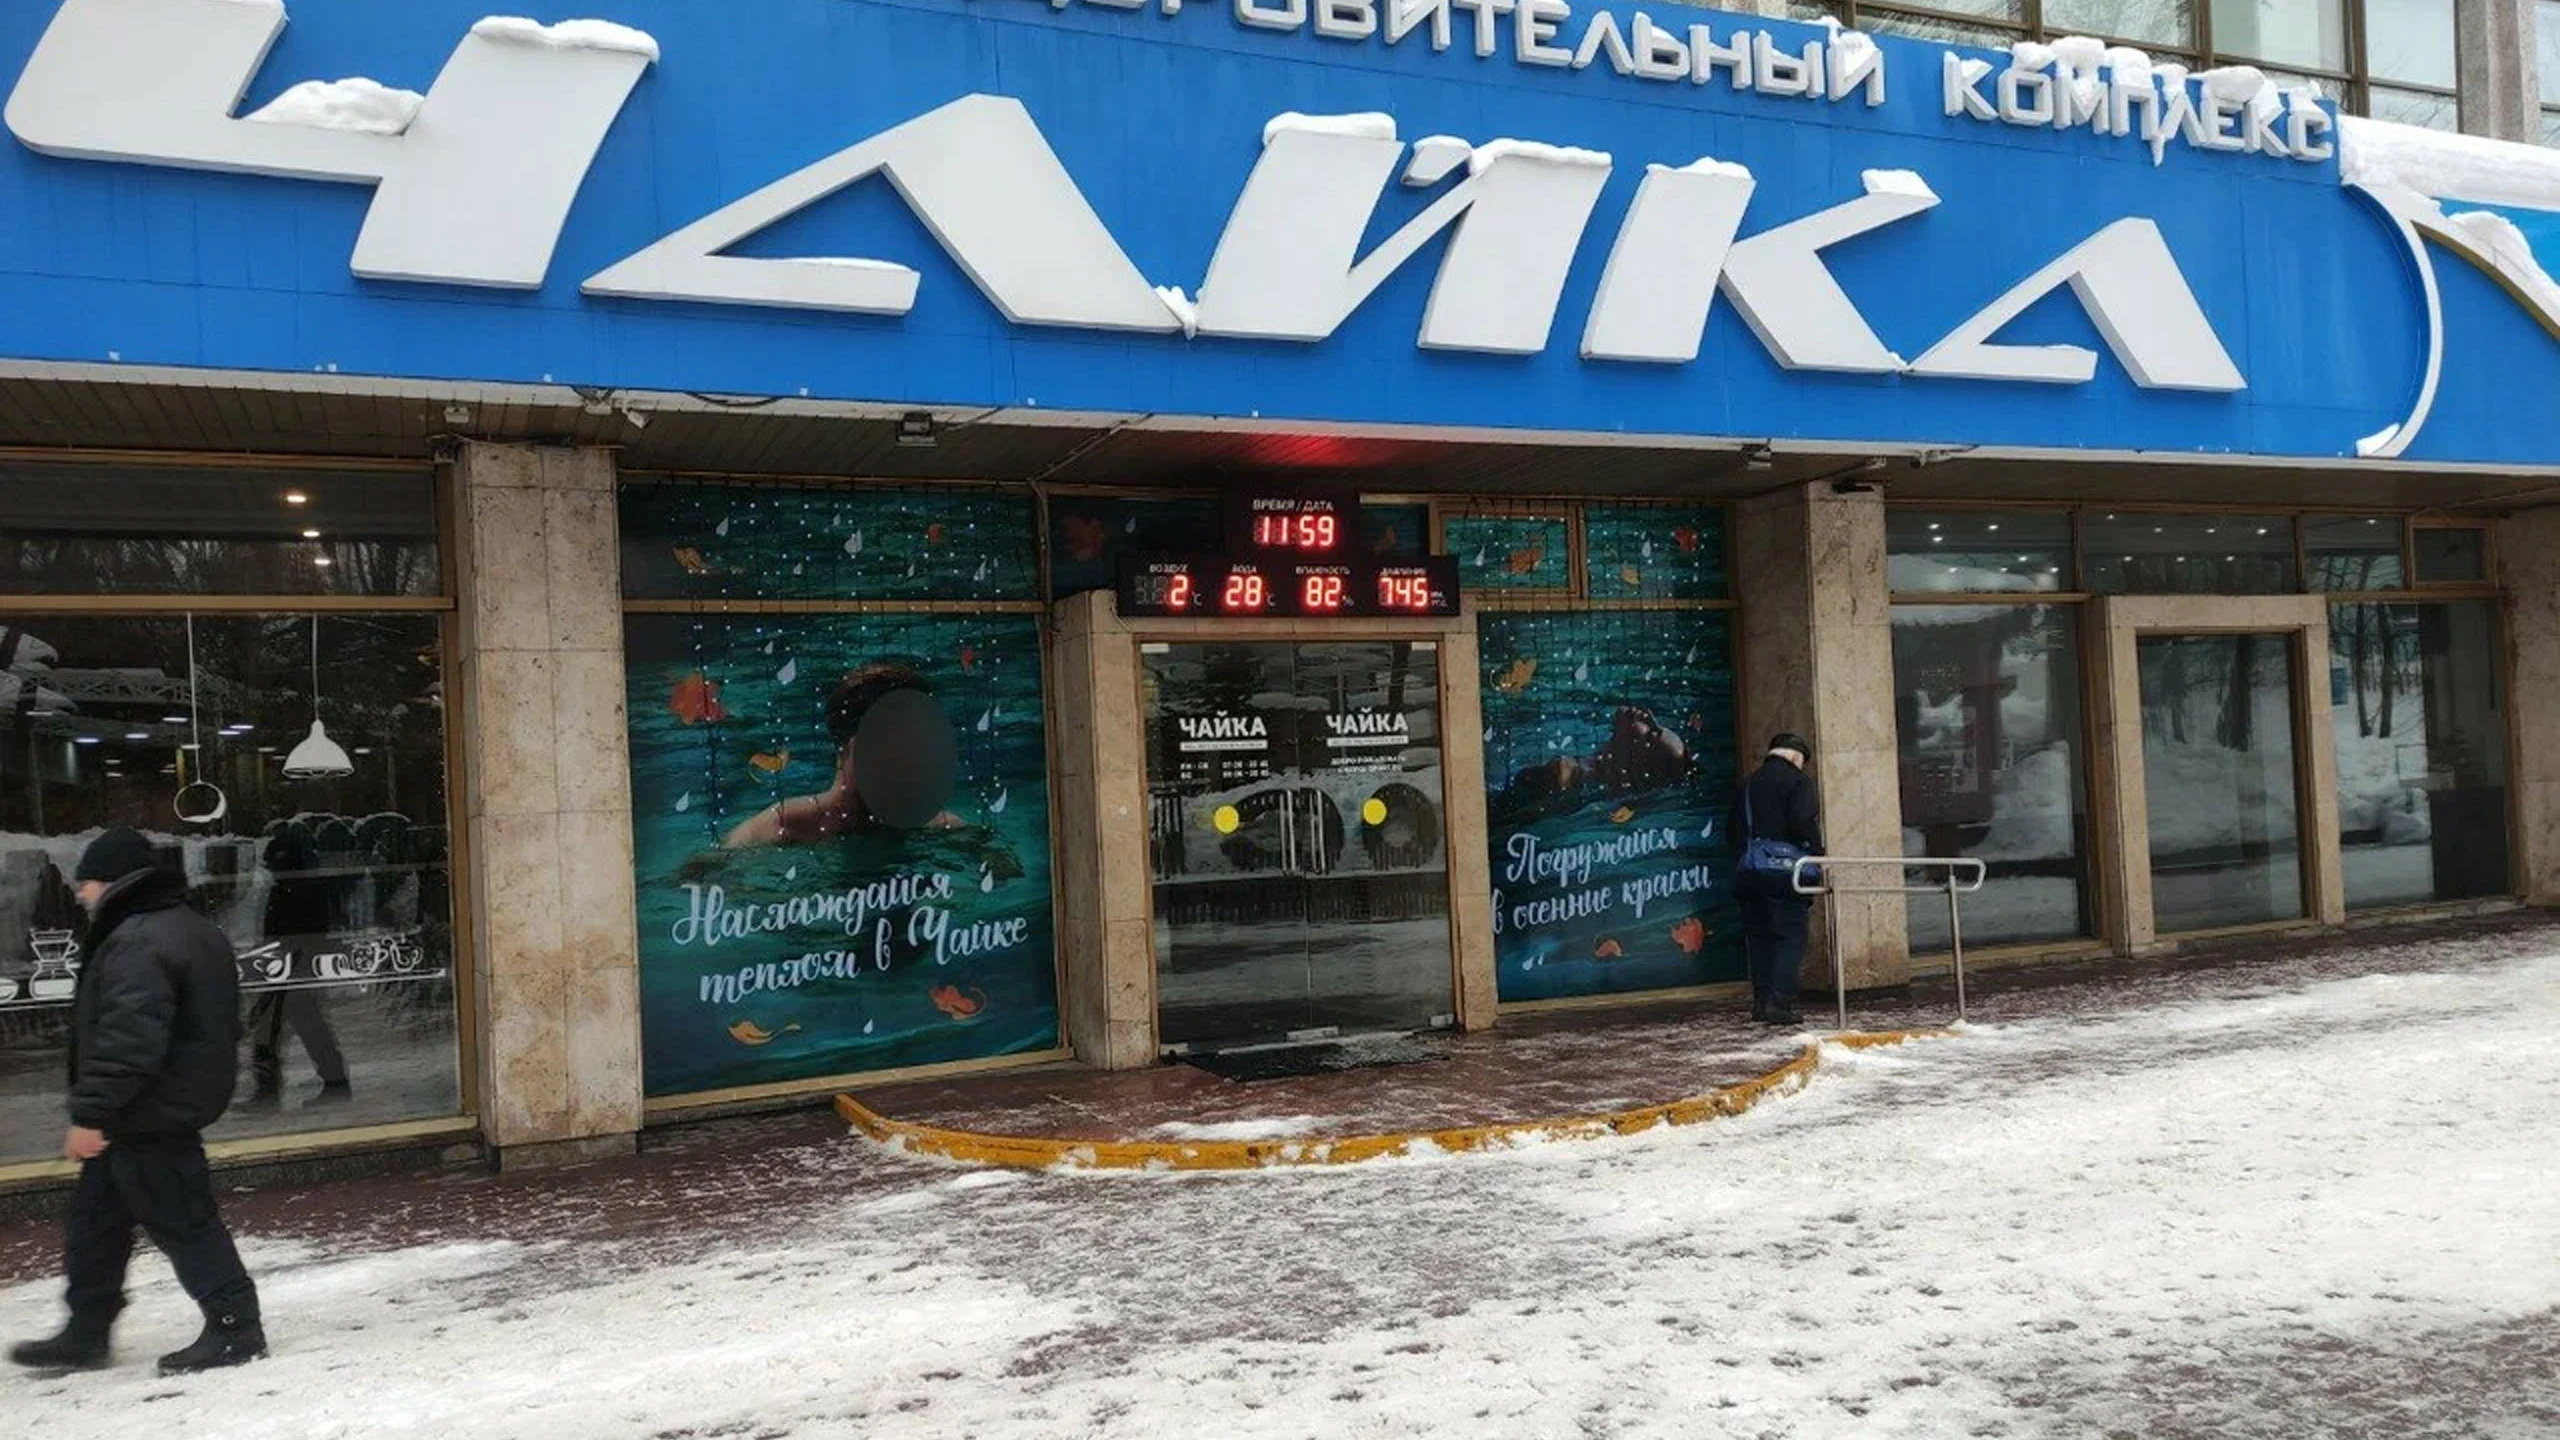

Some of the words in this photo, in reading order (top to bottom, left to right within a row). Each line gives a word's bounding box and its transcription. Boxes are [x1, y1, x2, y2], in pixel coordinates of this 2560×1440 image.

[1050, 0, 1885, 107] ВИТЕЛЬНЫЙ
[1943, 50, 2334, 162] КОМПЛЕКС
[4, 0, 2247, 393] ЧАЙКА
[1253, 499, 1295, 511] ВРЕМЯ
[1302, 501, 1334, 513] ДАТА
[1225, 575, 1263, 607] 28
[1306, 576, 1341, 607] 82
[1379, 577, 1428, 607] 745
[1179, 710, 1267, 739] ЧАЙКА
[1325, 707, 1409, 734] ЧАЙКА
[1507, 827, 1679, 888] Погружайся
[672, 871, 952, 946] Наслаждайся
[1513, 887, 1613, 930] осенние
[1622, 865, 1712, 919] краски
[700, 948, 860, 1004] теплом
[875, 918, 892, 971] в
[908, 906, 1029, 966] Чайке
